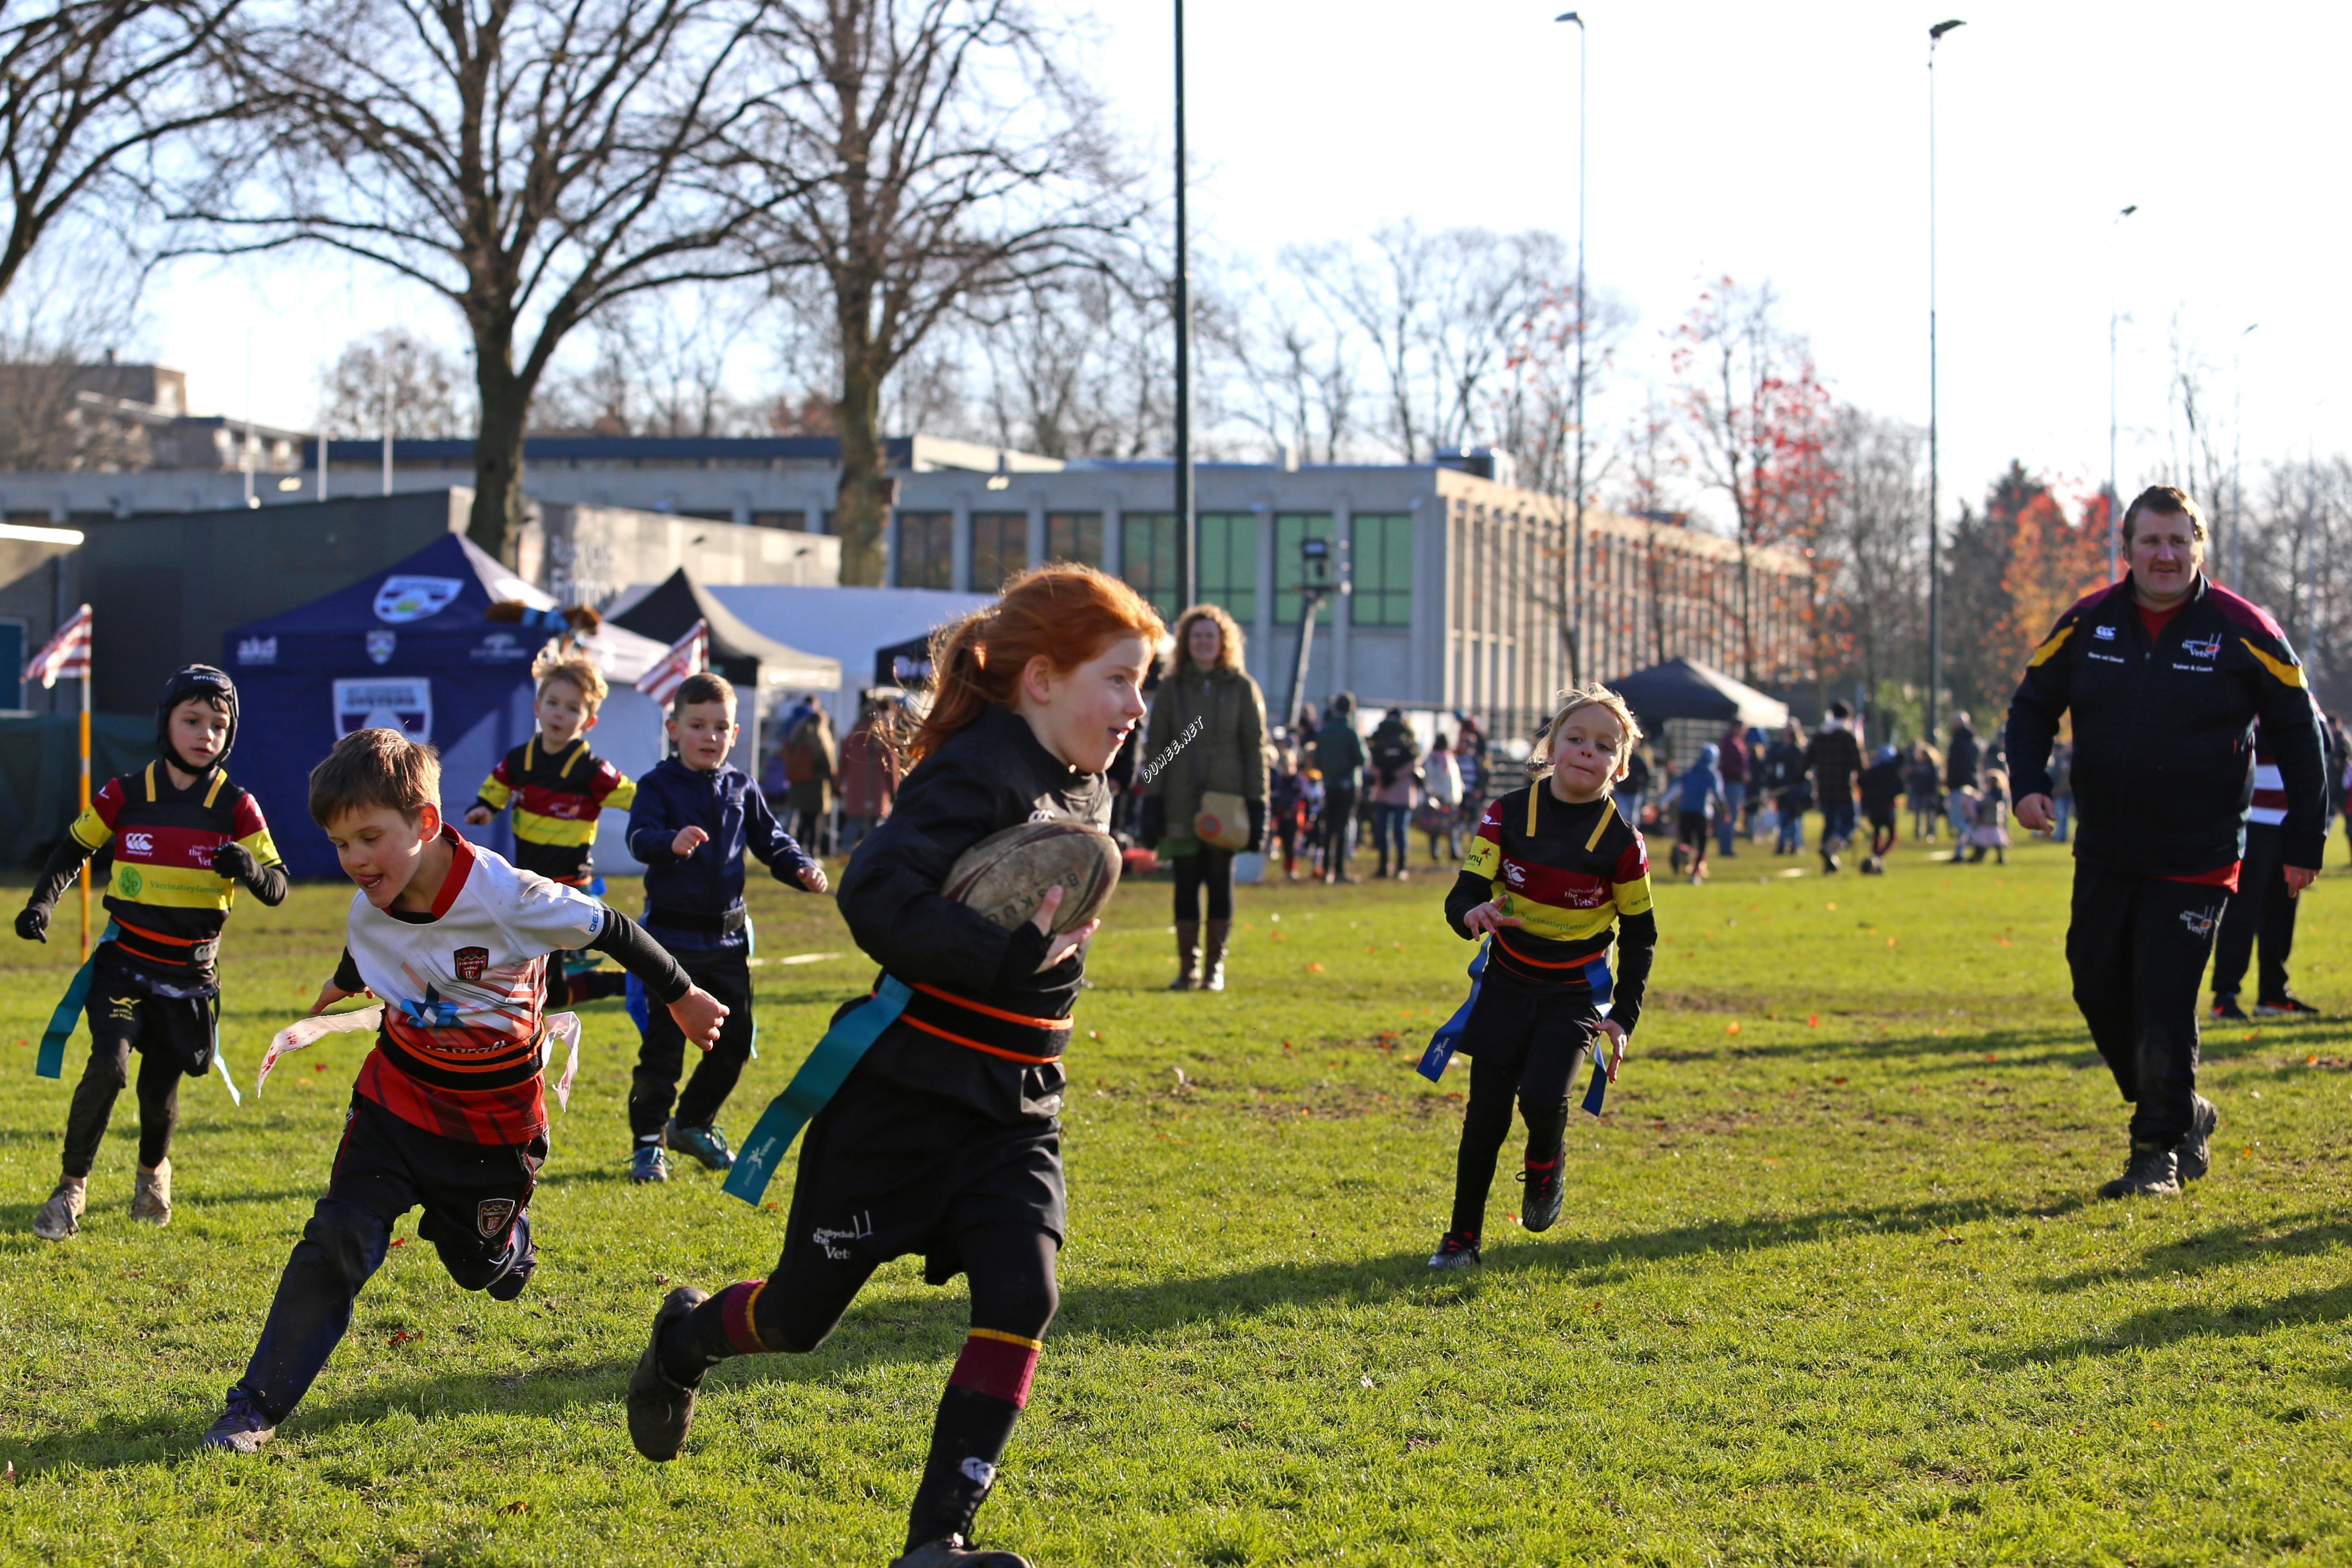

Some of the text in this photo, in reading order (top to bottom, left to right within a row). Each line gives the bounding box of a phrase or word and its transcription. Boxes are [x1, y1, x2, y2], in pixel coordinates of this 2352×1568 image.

[189, 848, 202, 857] the
[198, 856, 213, 866] Vet
[1564, 891, 1578, 899] the
[1573, 899, 1592, 907] Vets
[824, 1245, 850, 1259] Vet
